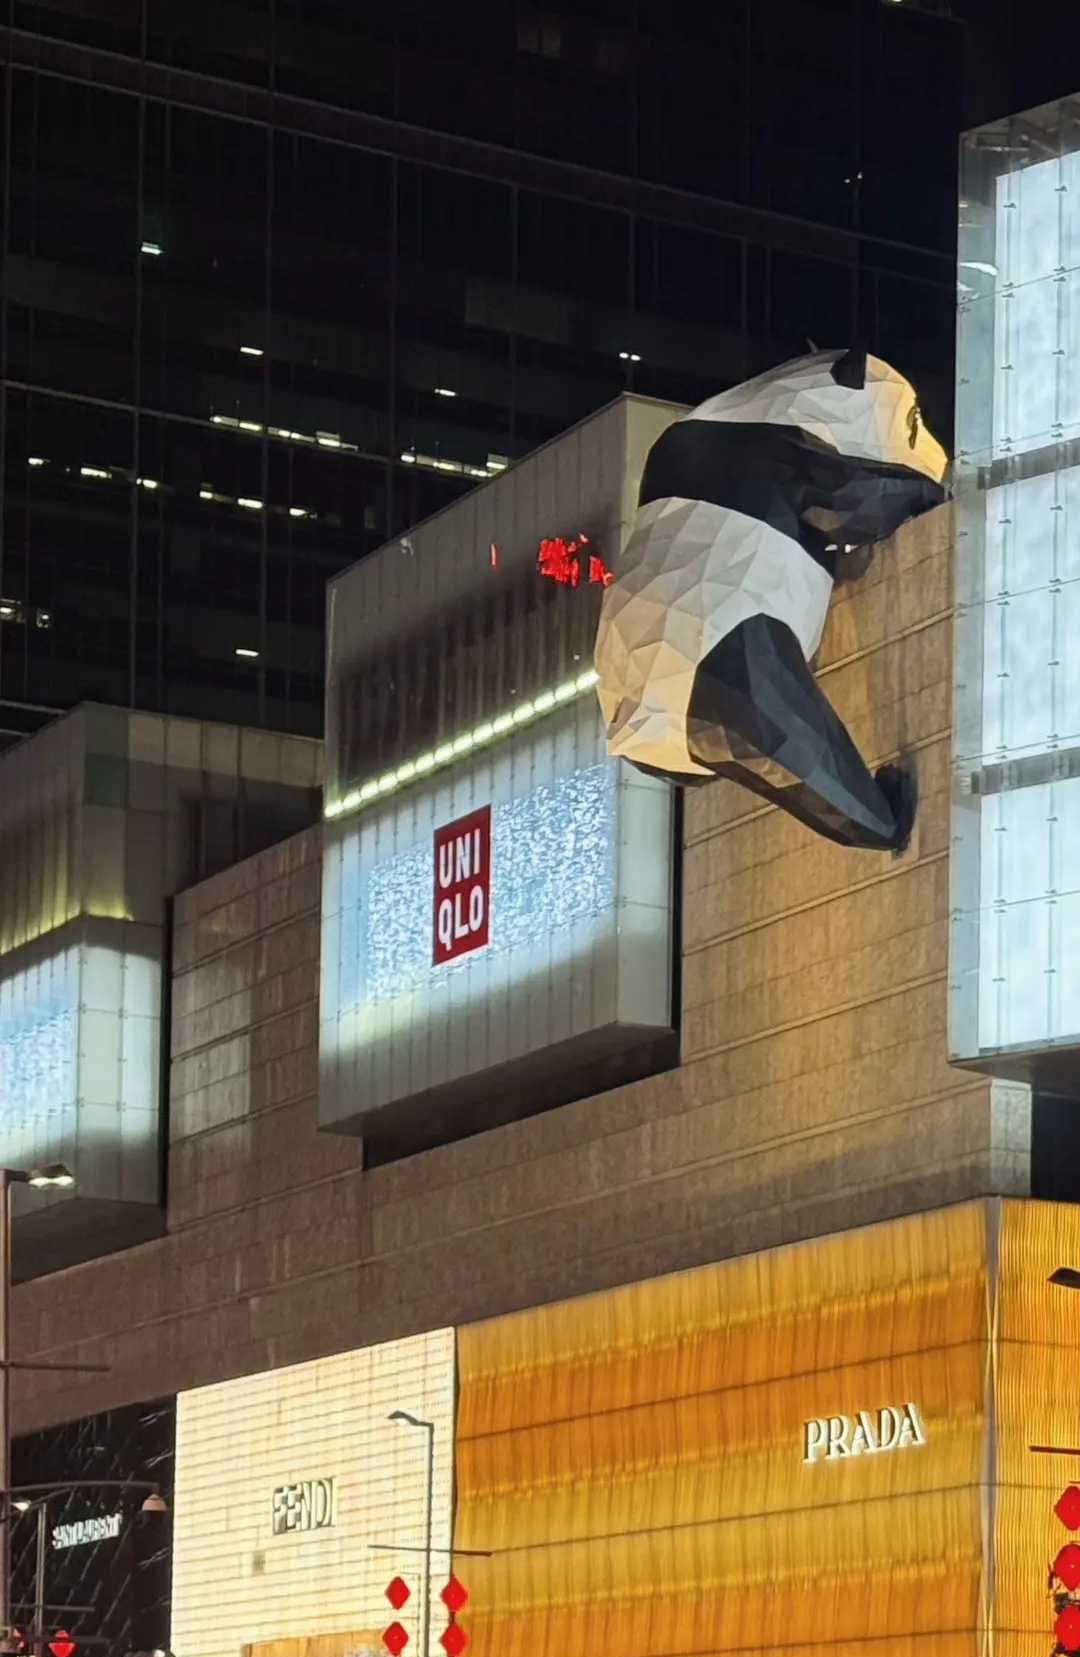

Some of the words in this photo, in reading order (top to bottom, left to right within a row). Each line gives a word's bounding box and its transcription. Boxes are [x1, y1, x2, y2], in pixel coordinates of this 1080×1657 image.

[438, 828, 481, 889] UNI
[438, 885, 484, 952] QLO
[802, 1402, 926, 1463] PRADA
[272, 1476, 336, 1536] FENDI
